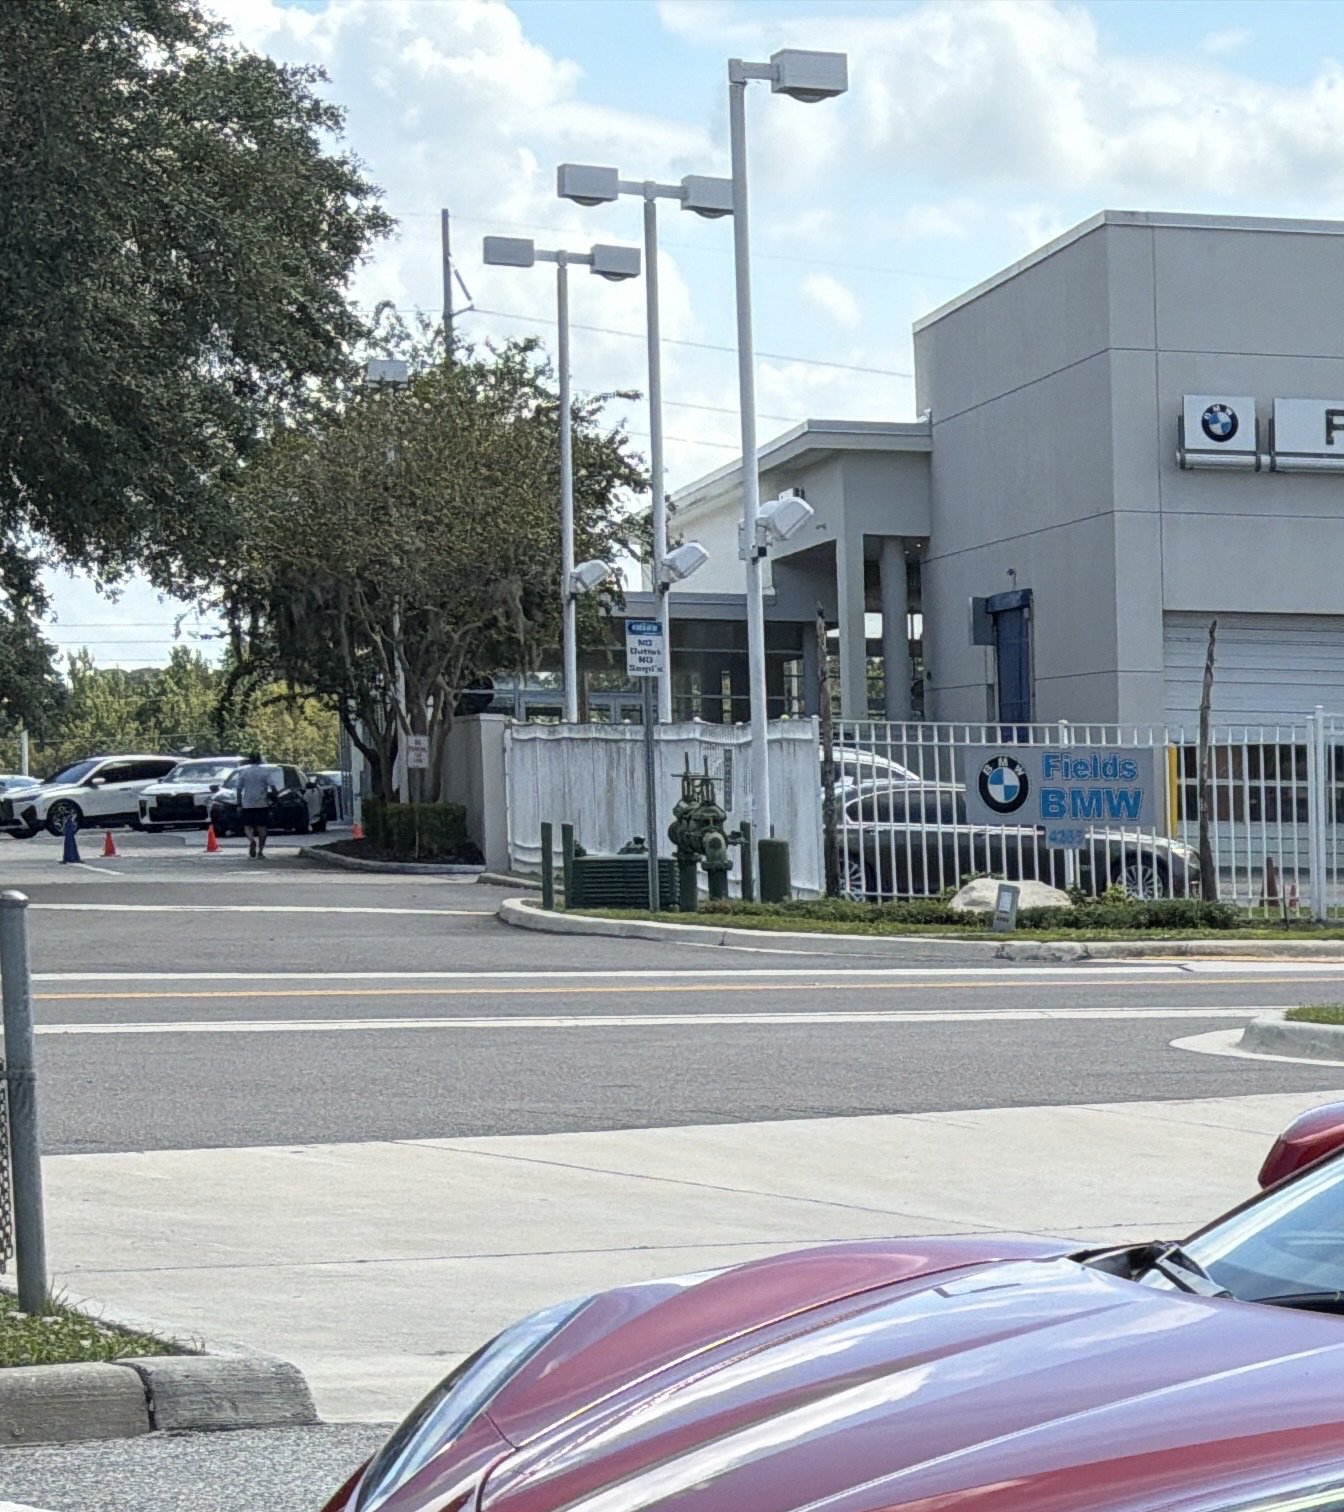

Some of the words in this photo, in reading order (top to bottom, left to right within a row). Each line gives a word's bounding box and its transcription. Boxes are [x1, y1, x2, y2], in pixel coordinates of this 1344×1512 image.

[982, 755, 1026, 776] BMW
[1041, 751, 1138, 782] Fields
[1039, 786, 1144, 821] BMW
